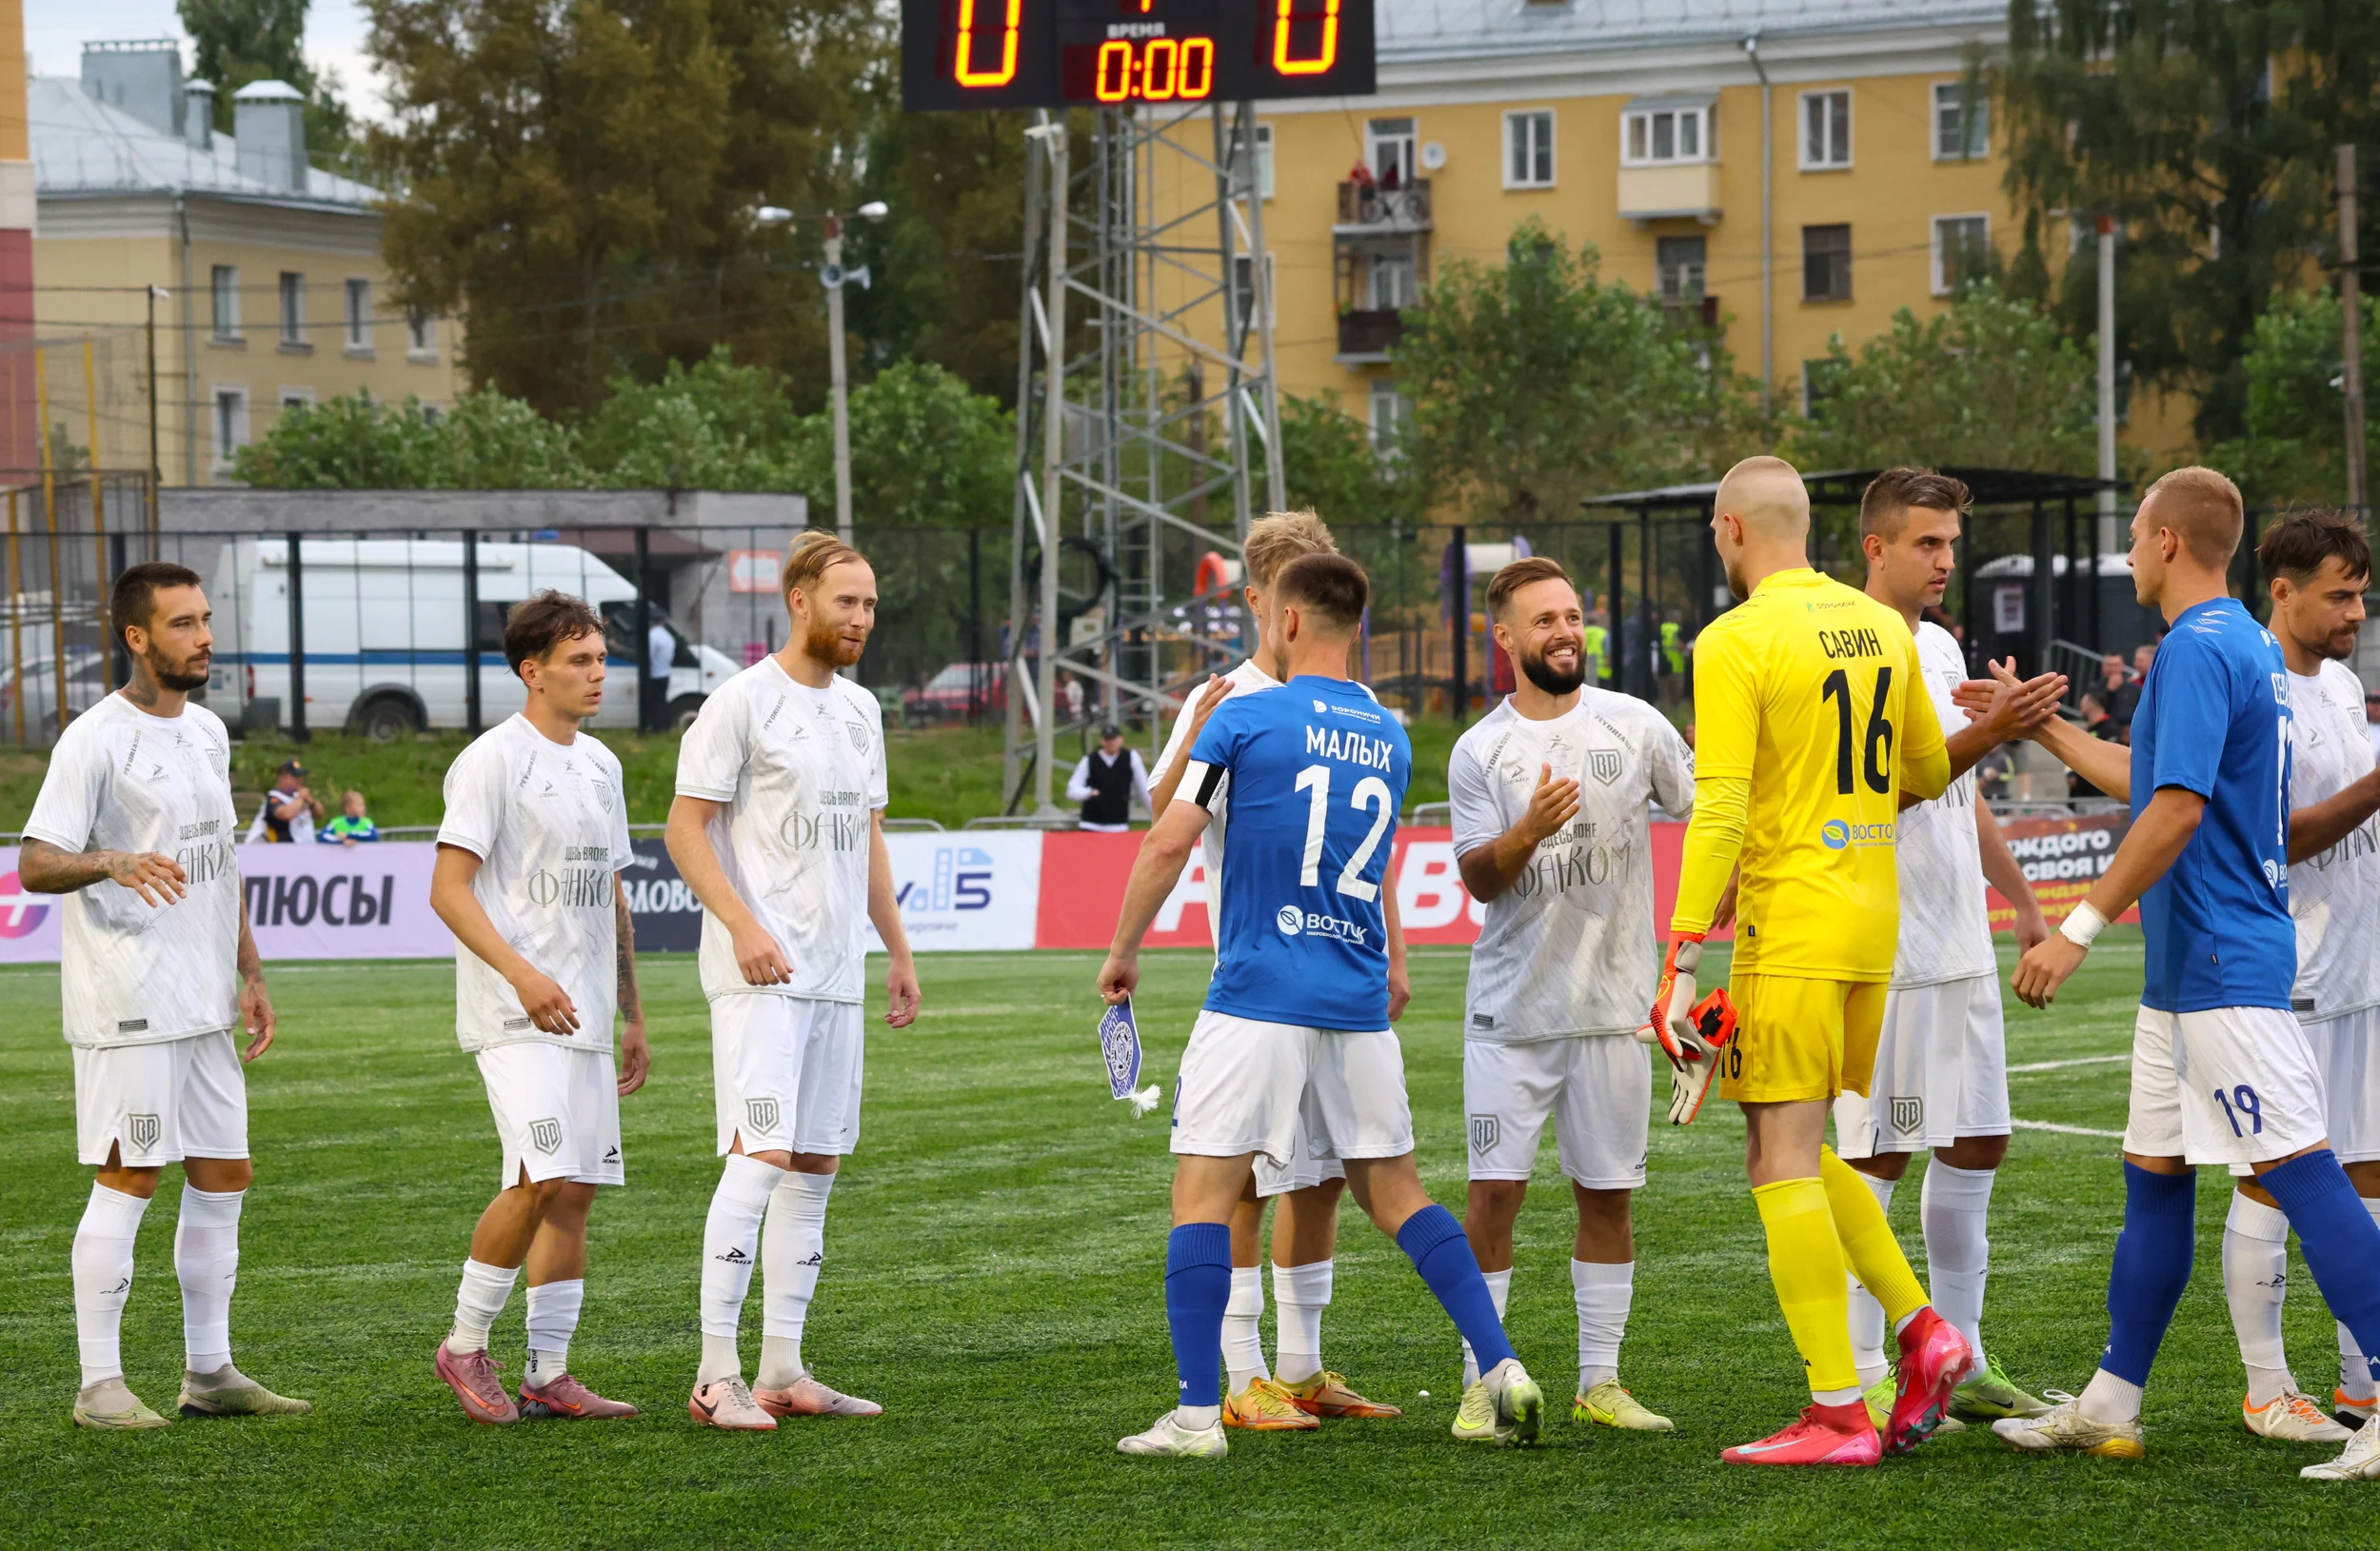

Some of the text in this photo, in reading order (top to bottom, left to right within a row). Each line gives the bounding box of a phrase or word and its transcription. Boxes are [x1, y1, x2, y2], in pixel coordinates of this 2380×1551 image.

[1107, 23, 1165, 38] ВРЕМЯ
[1096, 37, 1214, 102] 0:00
[1818, 628, 1883, 659] САВИН
[1823, 666, 1894, 795] 16
[1306, 725, 1394, 773] МАЛЫХ
[199, 819, 220, 836] BROE
[1294, 764, 1393, 904] 12
[1853, 824, 1893, 840] ВОСТО
[2022, 856, 2092, 882] СВОЯ
[528, 867, 614, 909] ФАНКО
[621, 878, 703, 913] ВЛОВС
[2213, 1084, 2262, 1138] 19
[715, 1254, 753, 1265] DEMIX
